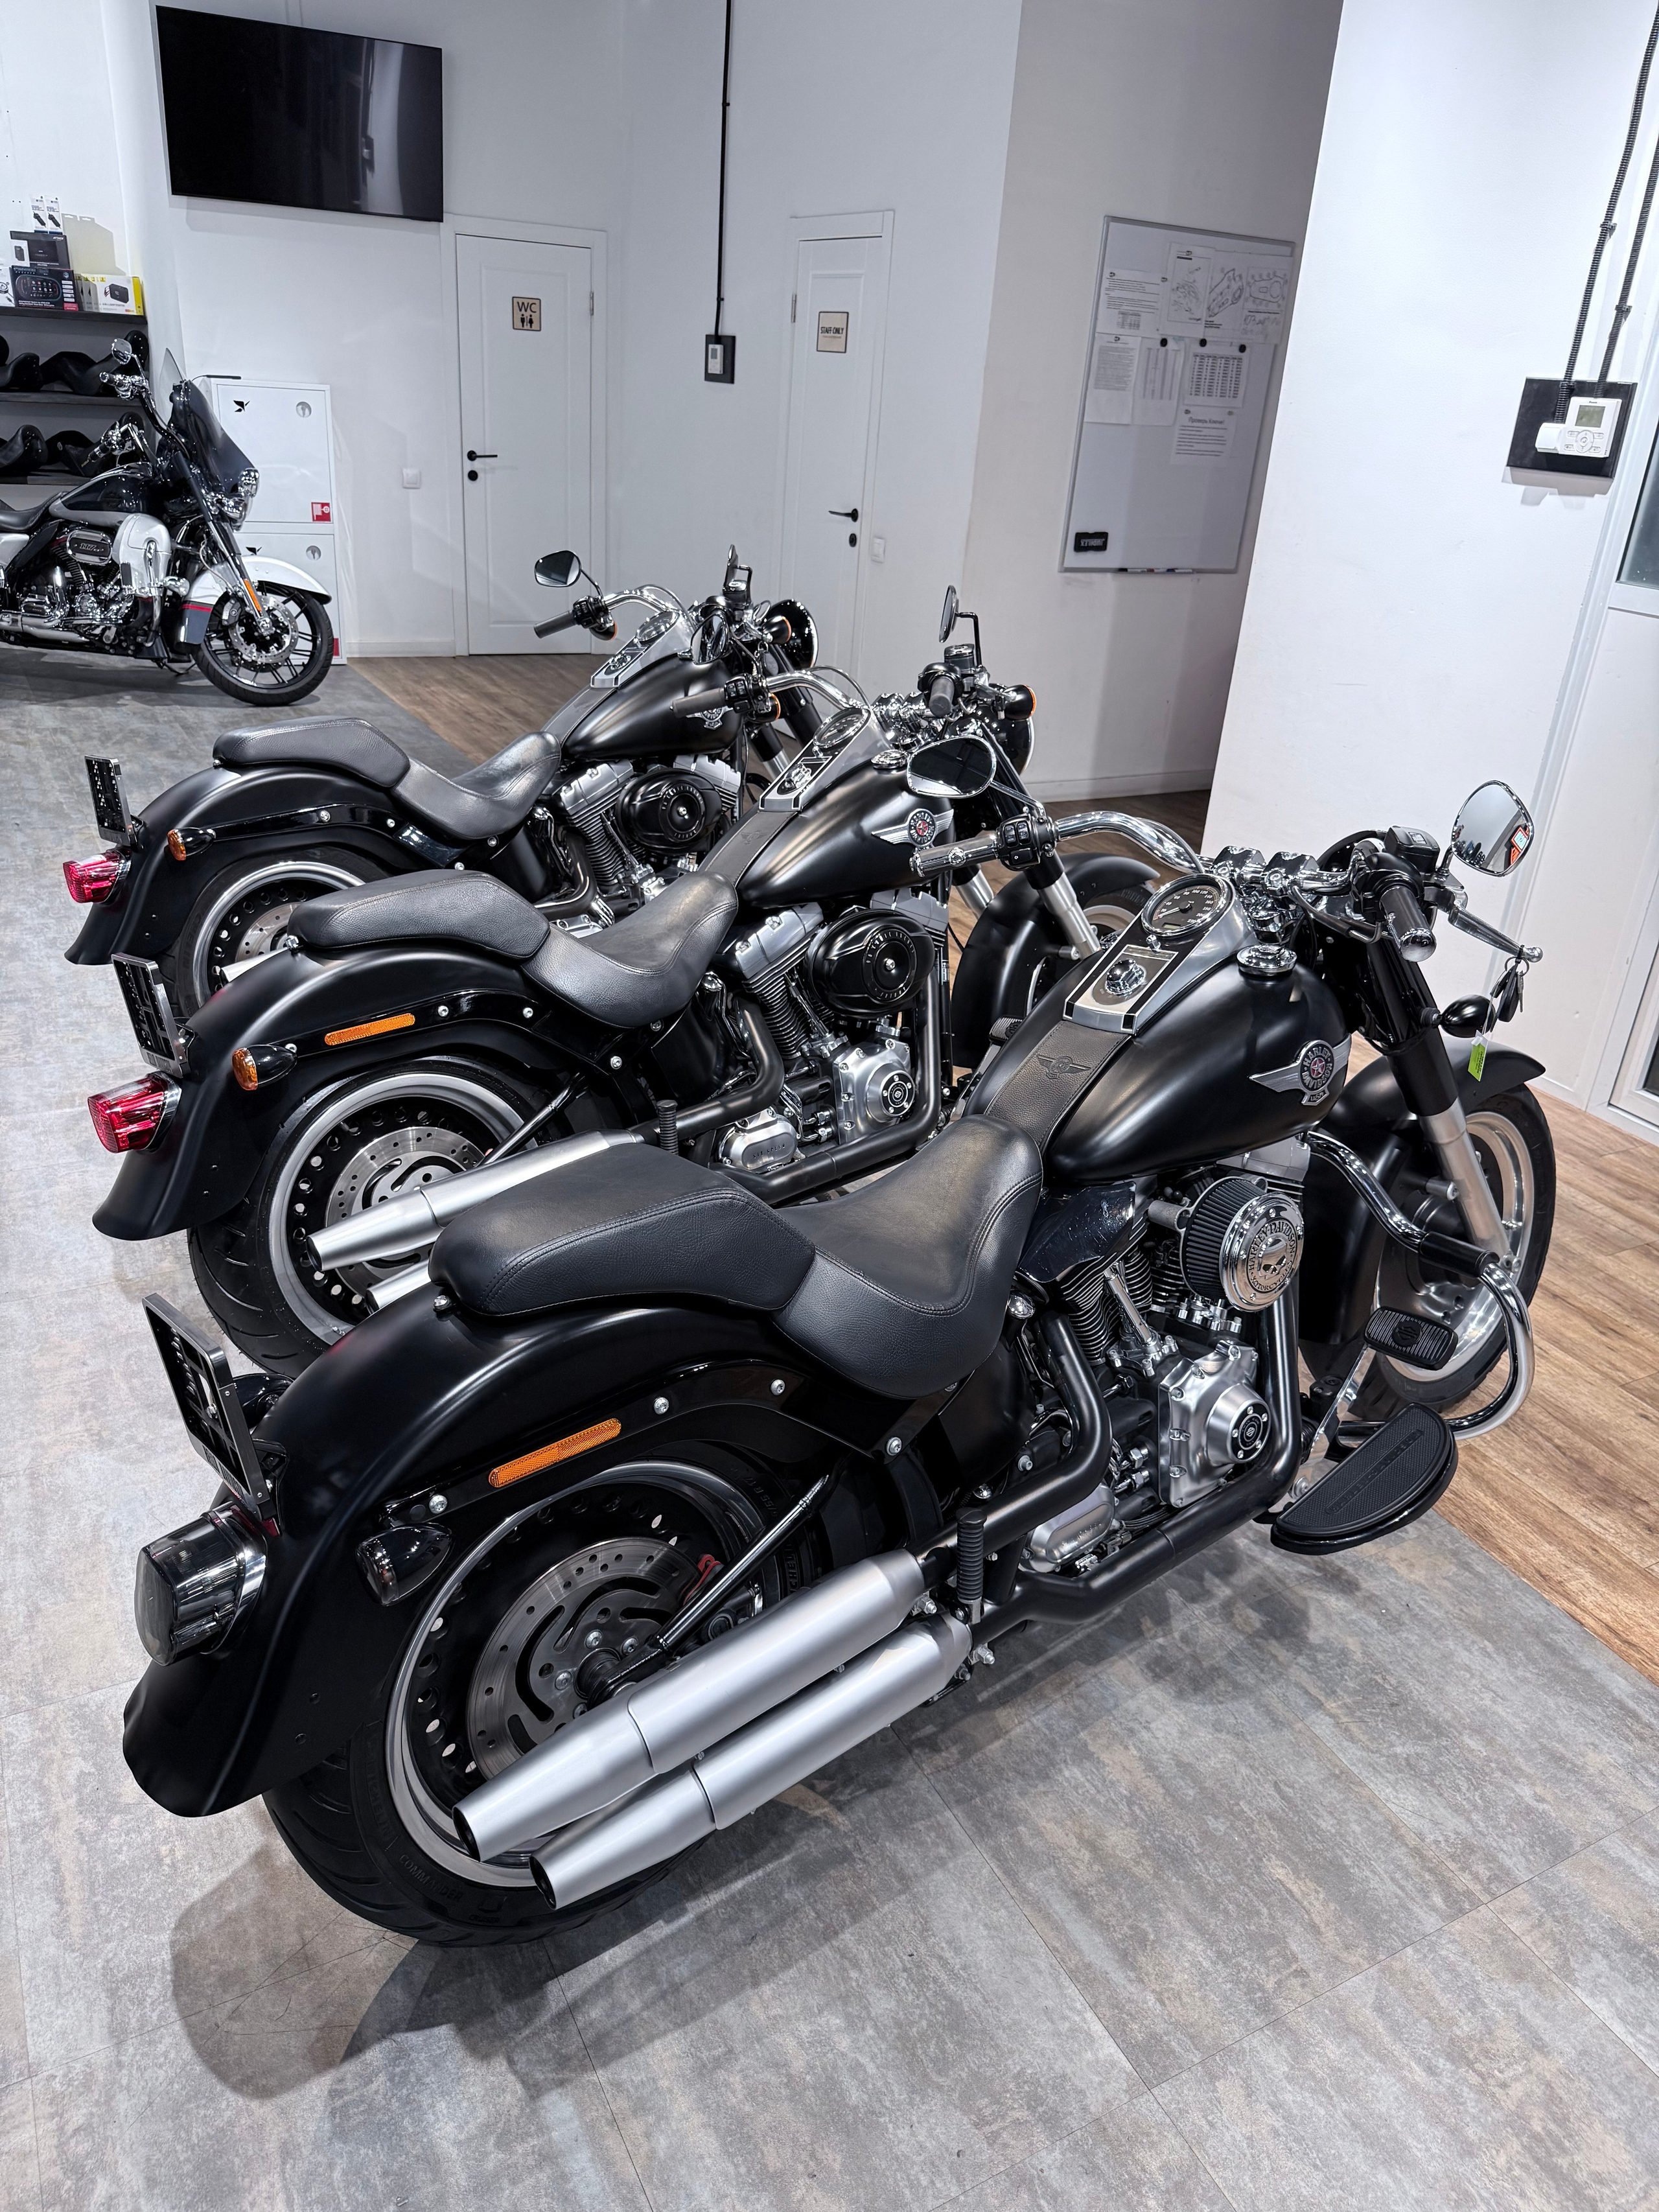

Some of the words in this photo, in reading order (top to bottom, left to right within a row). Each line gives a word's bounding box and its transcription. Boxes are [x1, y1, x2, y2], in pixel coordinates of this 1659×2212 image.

[516, 301, 537, 313] WC
[79, 542, 97, 551] 117
[1303, 1046, 1331, 1067] HARLEY
[1301, 1063, 1333, 1089] DAVIDSON
[1310, 1091, 1324, 1101] USA
[1251, 1260, 1293, 1291] MOTORCYCLES
[399, 1854, 464, 1903] COMMANDER
[469, 1915, 500, 1924] CRUISER
